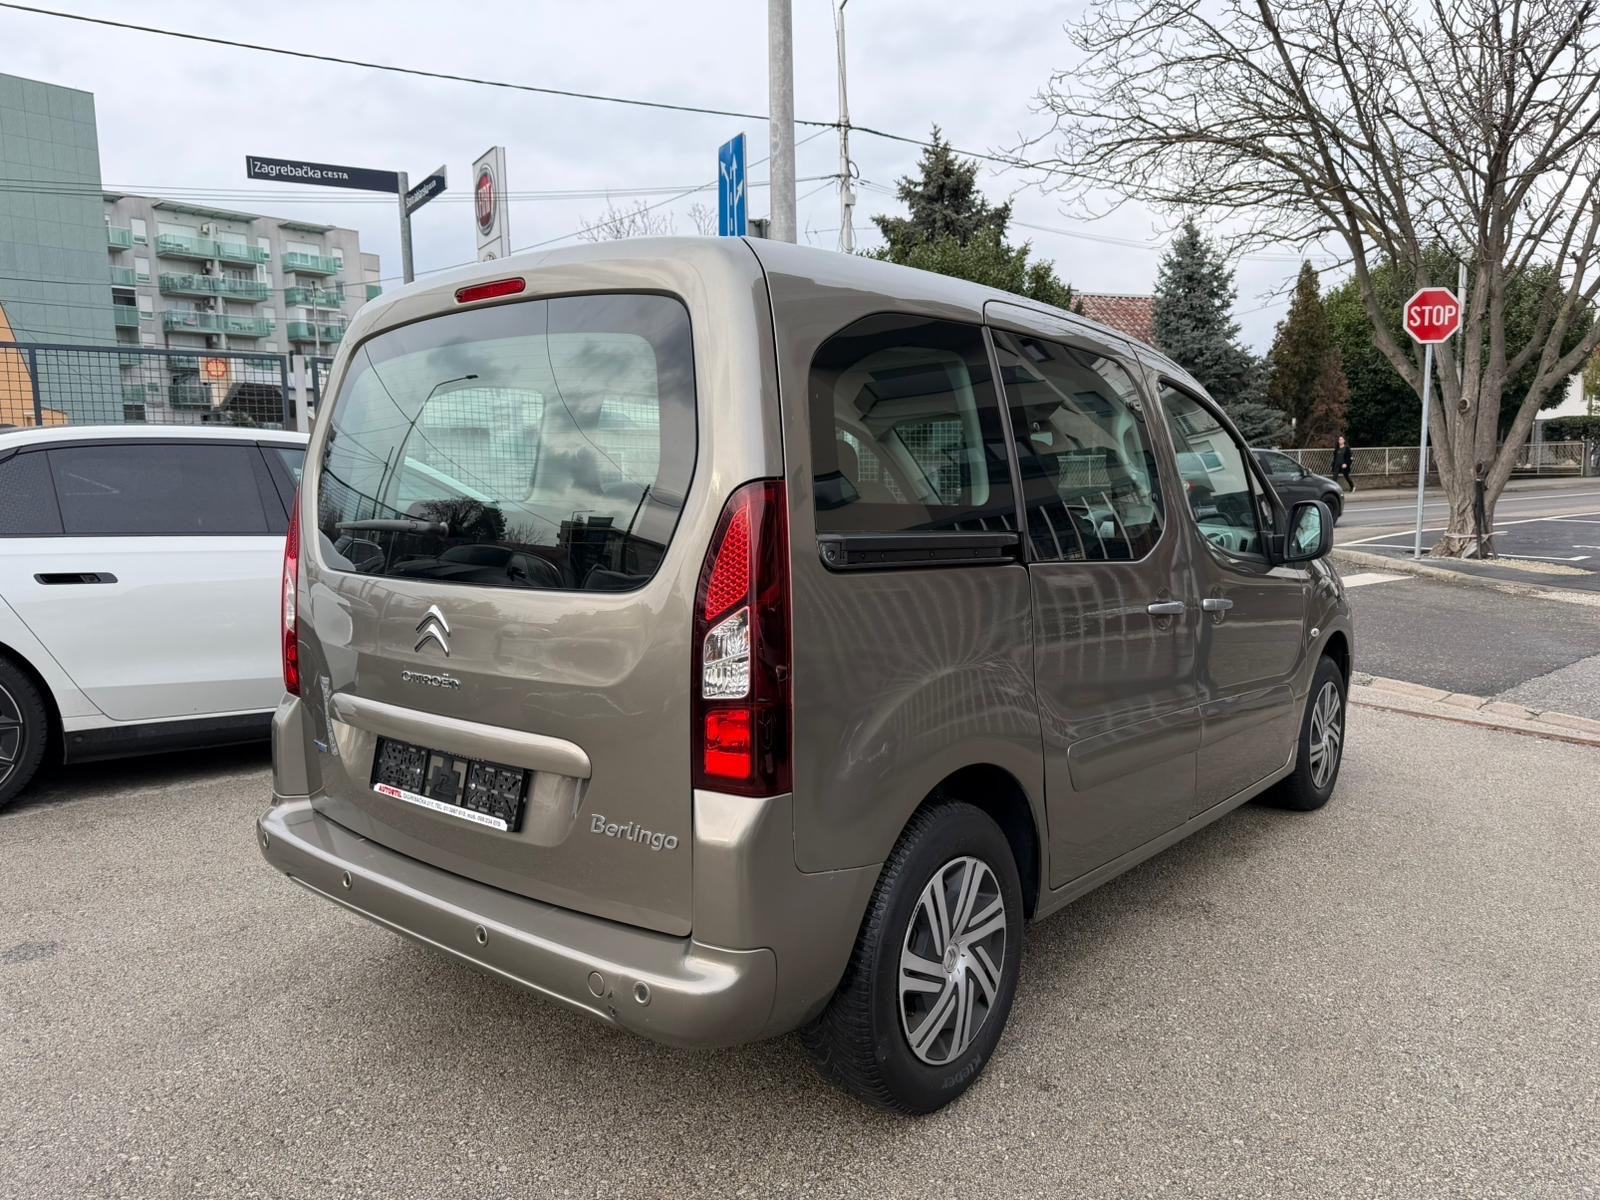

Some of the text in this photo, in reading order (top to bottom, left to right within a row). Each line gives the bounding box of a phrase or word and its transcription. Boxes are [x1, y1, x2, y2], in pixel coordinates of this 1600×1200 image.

[254, 161, 349, 180] Zagrebačka CESTA
[1409, 304, 1457, 328] STOP
[401, 670, 460, 690] CITROËN
[590, 813, 679, 851] Berlingo
